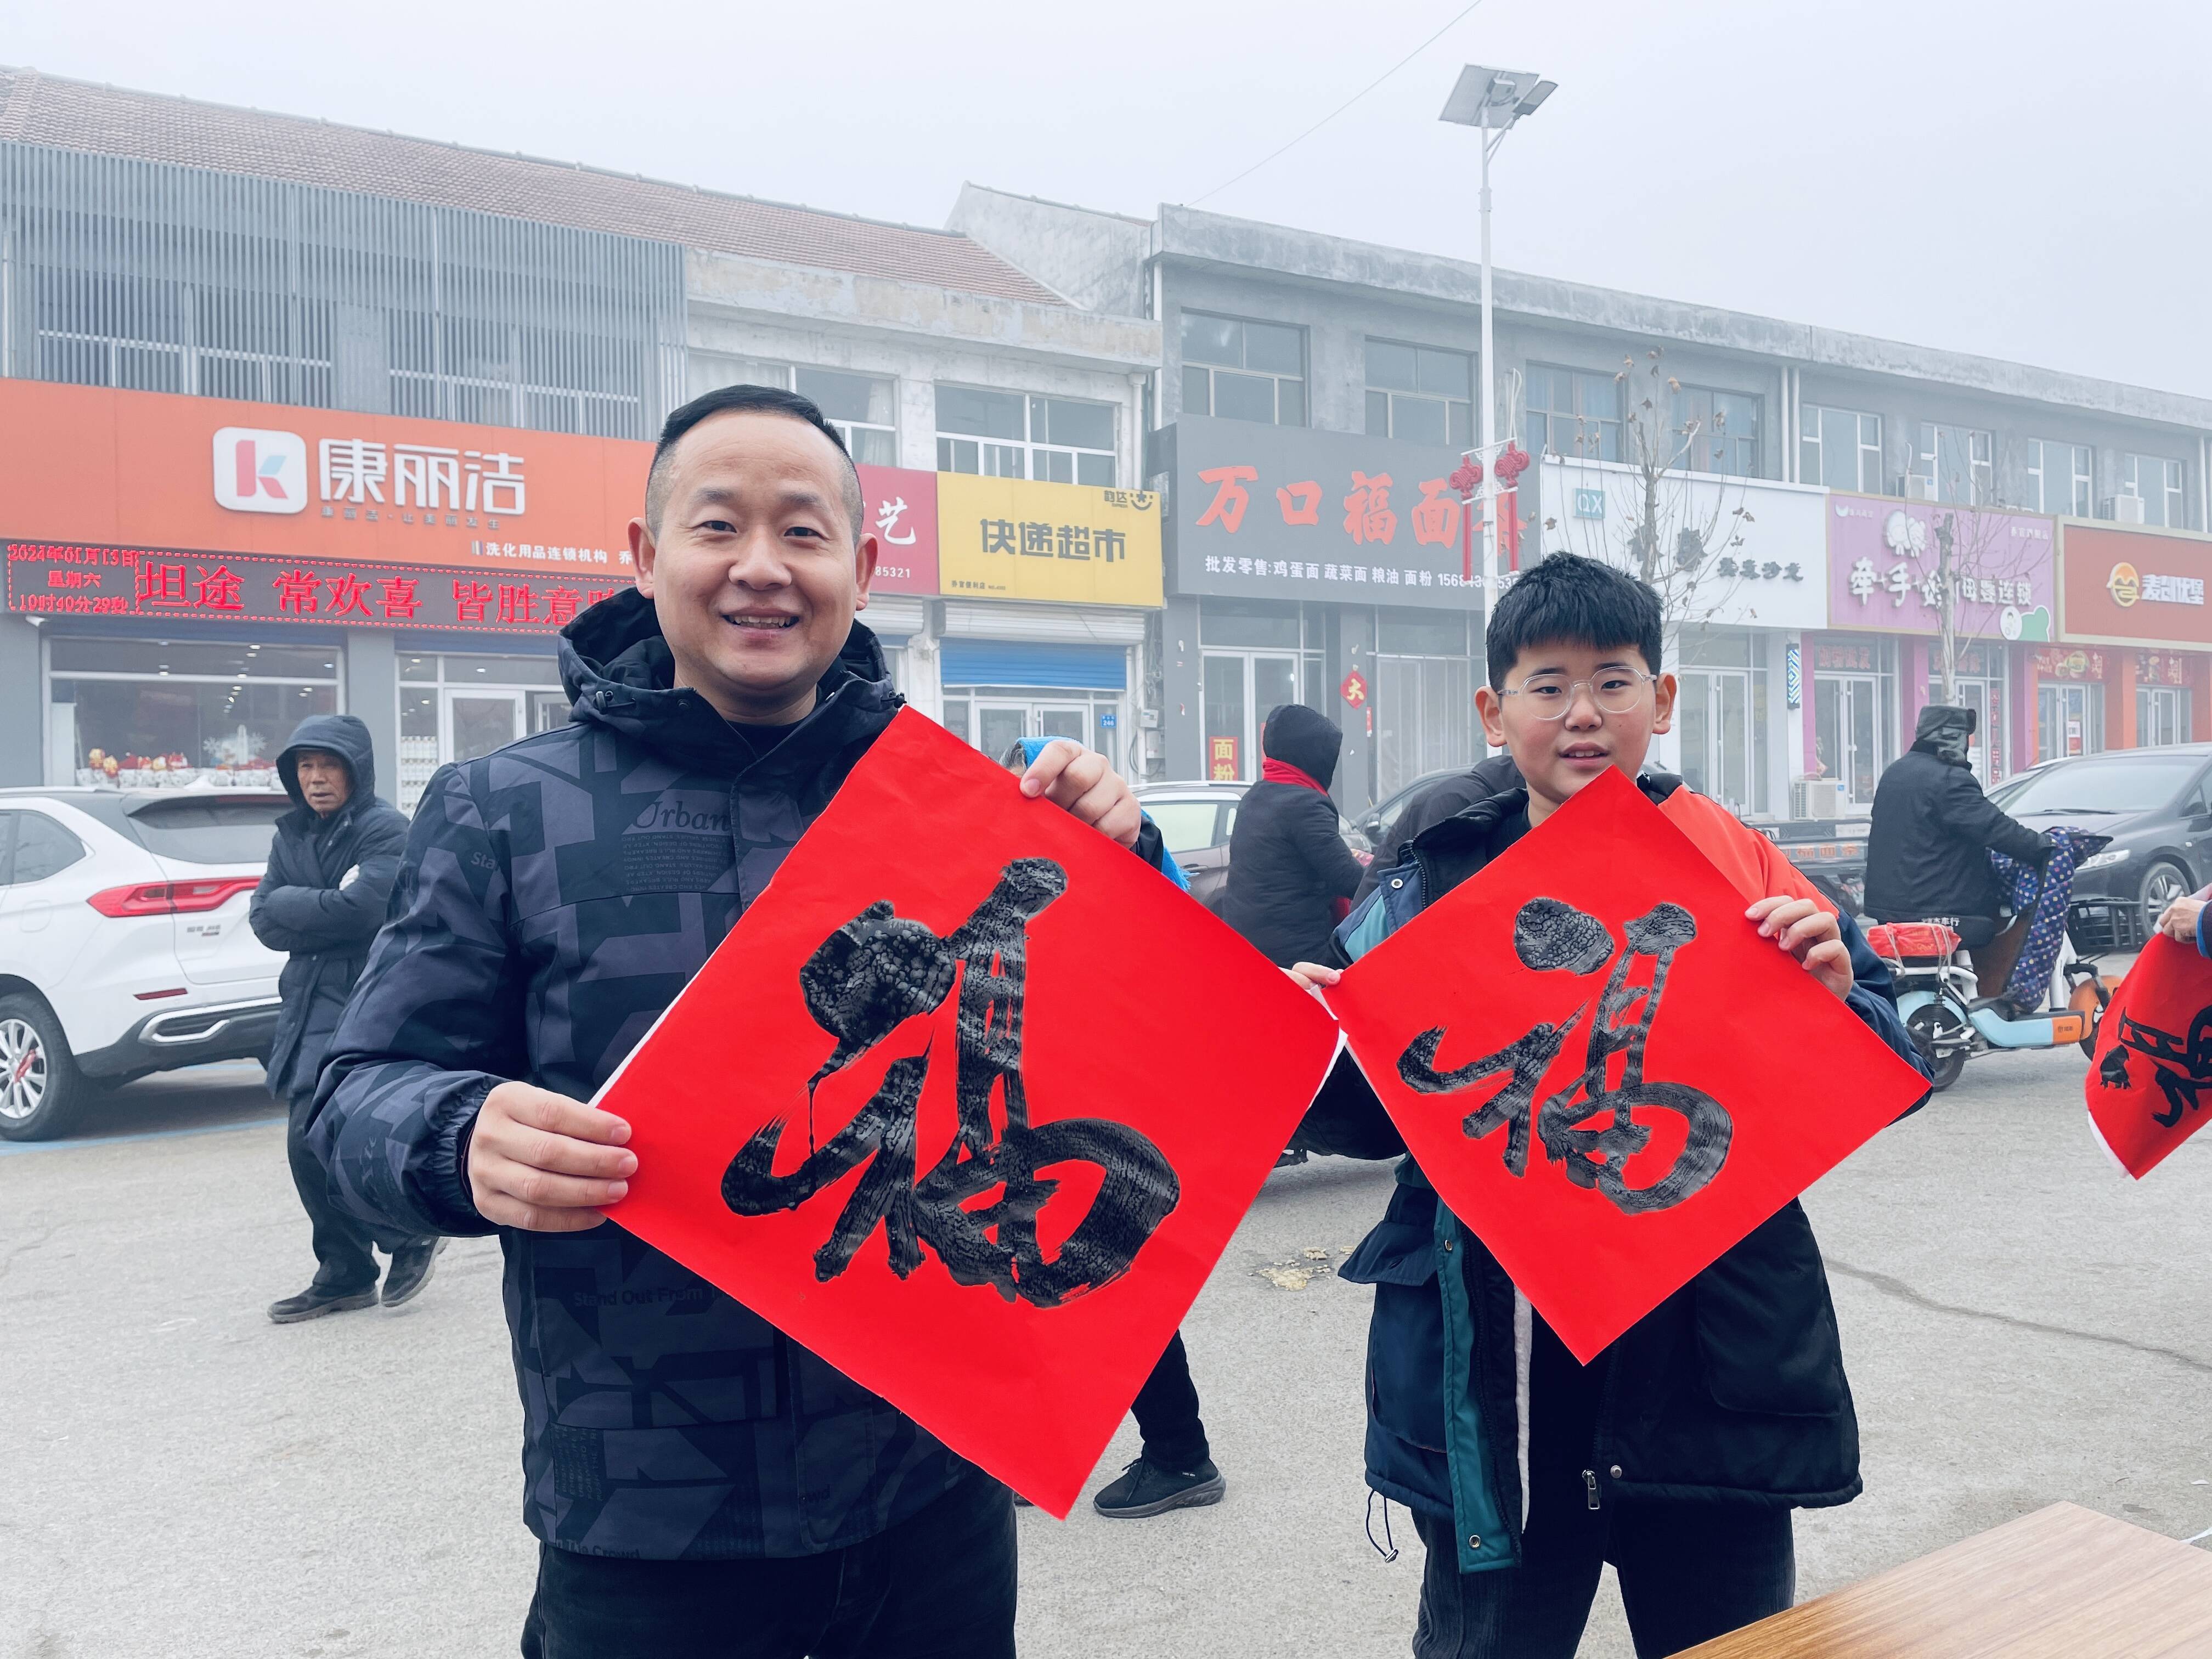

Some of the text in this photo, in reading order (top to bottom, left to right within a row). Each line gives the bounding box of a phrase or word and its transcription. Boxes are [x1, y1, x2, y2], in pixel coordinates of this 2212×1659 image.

[319, 439, 525, 515] 康丽洁
[1104, 490, 1127, 503] 韵达
[876, 496, 916, 545] 艺
[486, 542, 607, 563] 洗化用品连锁机构
[980, 518, 1126, 563] 快递超市
[8, 544, 136, 567] 2024年01月13日
[48, 570, 101, 589] 星期六
[875, 566, 911, 578] 85321
[1324, 563, 1368, 584] 蔬菜面
[1372, 566, 1399, 585] 粮油
[1404, 570, 1432, 587] 面粉
[138, 561, 245, 611] 坦途
[273, 569, 423, 619] 常欢喜
[19, 593, 128, 614] 10时40分29秒
[1213, 738, 1235, 780] 面粉
[470, 851, 496, 870] Sta
[1397, 896, 1734, 1215] 福
[721, 857, 1181, 1309] 福
